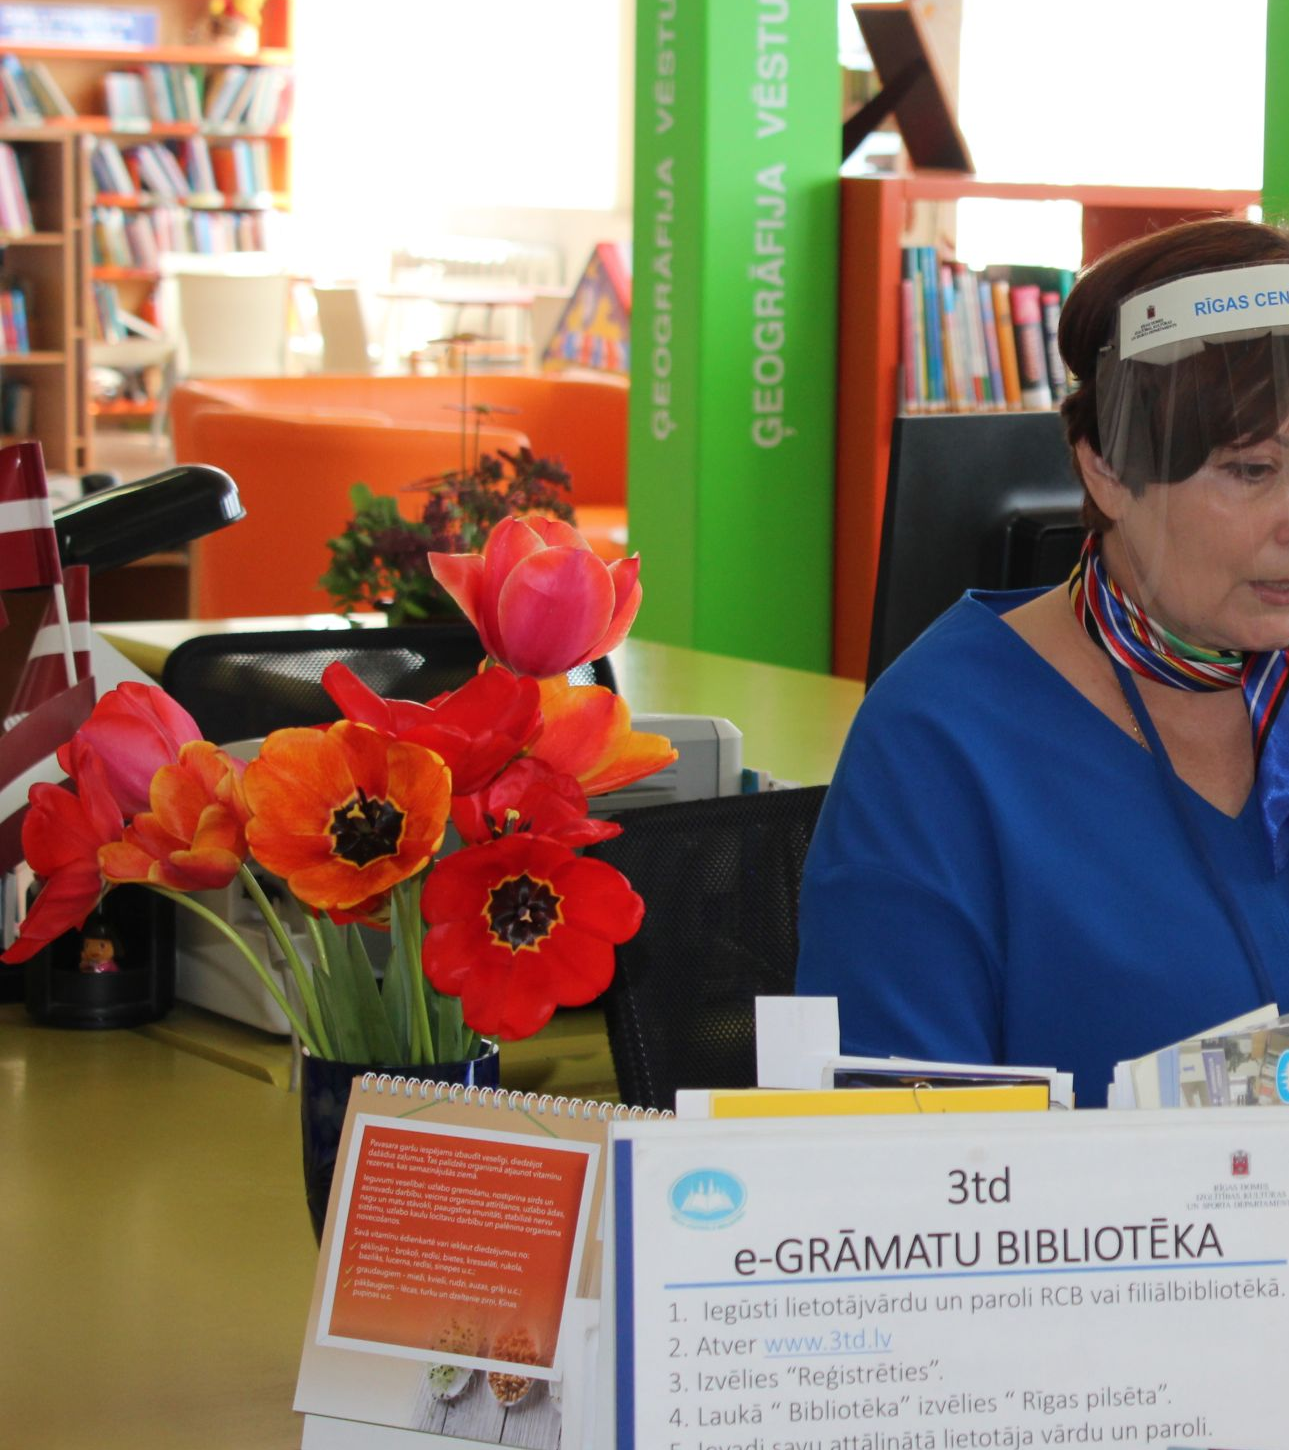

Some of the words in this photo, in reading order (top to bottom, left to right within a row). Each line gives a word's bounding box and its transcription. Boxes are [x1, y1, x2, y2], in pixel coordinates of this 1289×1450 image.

[752, 0, 789, 139] VĒSTU
[749, 162, 798, 449] ĢEOGRĀFIJA
[1194, 295, 1249, 317] RĪGAS
[947, 1166, 1012, 1205] 3td
[734, 1229, 981, 1276] e-GRĀMATU
[997, 1218, 1224, 1266] BIBLIOTĒKA
[668, 1302, 687, 1323] 1.
[703, 1300, 778, 1325] Iegūsti
[786, 1291, 928, 1319] lietotājvārdu
[936, 1294, 962, 1311] un
[971, 1286, 1033, 1314] paroli
[1041, 1286, 1084, 1307] RCB
[1091, 1284, 1120, 1304] vai
[1128, 1278, 1286, 1304] filiālbibliotēkā.
[668, 1338, 687, 1358] 2.
[696, 1336, 758, 1357] Atver
[764, 1328, 893, 1354] www.3td.lv
[669, 1373, 688, 1393] 3.
[697, 1369, 779, 1392] Izvēlies
[669, 1409, 688, 1428] 4.
[698, 1404, 763, 1427] Laukā
[918, 1393, 997, 1416] izvēlies
[1023, 1389, 1078, 1415] Rīgas
[944, 1427, 1034, 1450] lietotāja
[1041, 1422, 1103, 1444] vārdu
[1112, 1425, 1138, 1441] un
[1146, 1416, 1213, 1441] paroli.
